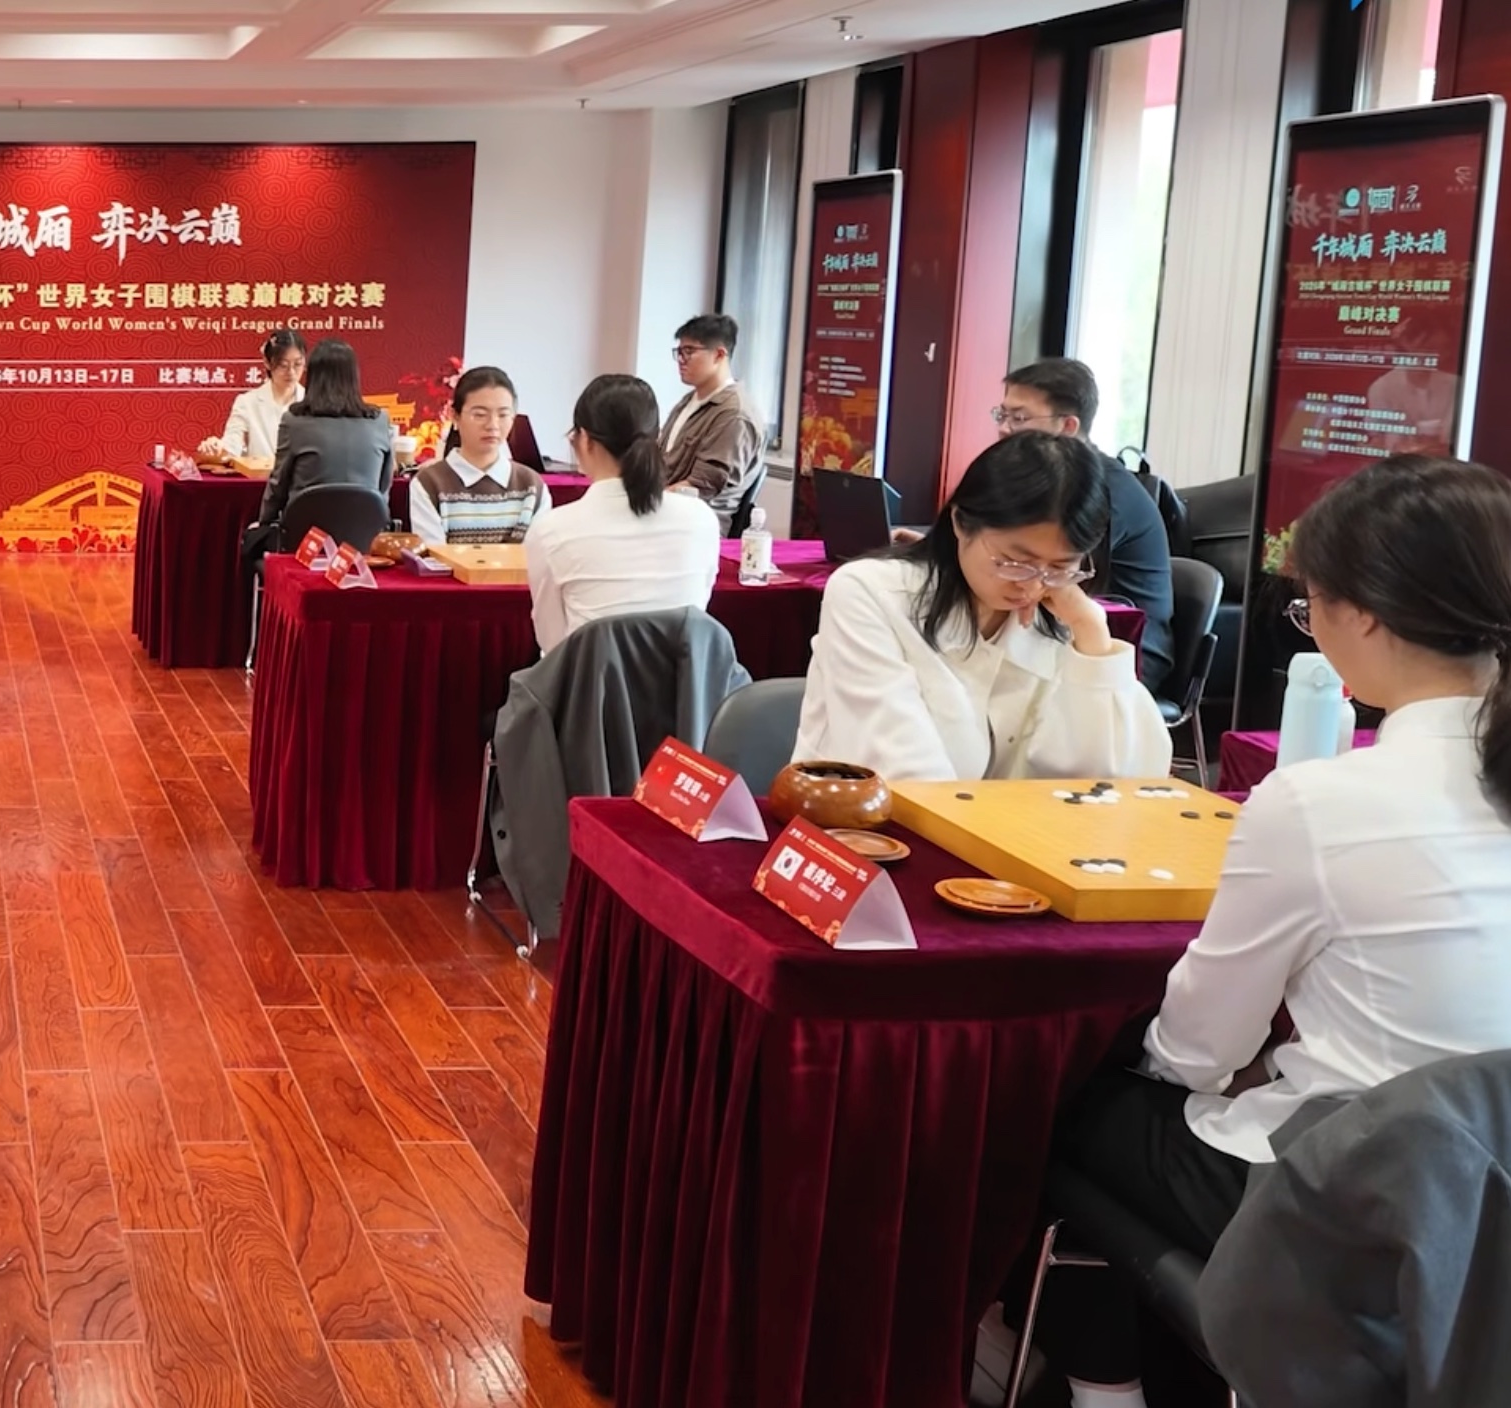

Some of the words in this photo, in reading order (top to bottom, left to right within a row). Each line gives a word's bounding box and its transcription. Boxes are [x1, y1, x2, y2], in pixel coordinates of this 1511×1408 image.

[91, 201, 242, 266] 弈决云巅
[20, 317, 50, 334] Cup
[56, 316, 103, 331] World
[108, 316, 177, 331] Women's
[182, 316, 227, 333] Weiqi
[232, 316, 283, 333] League
[287, 316, 334, 331] Grand
[339, 316, 385, 331] Finals
[158, 367, 267, 385] 比赛地点：北
